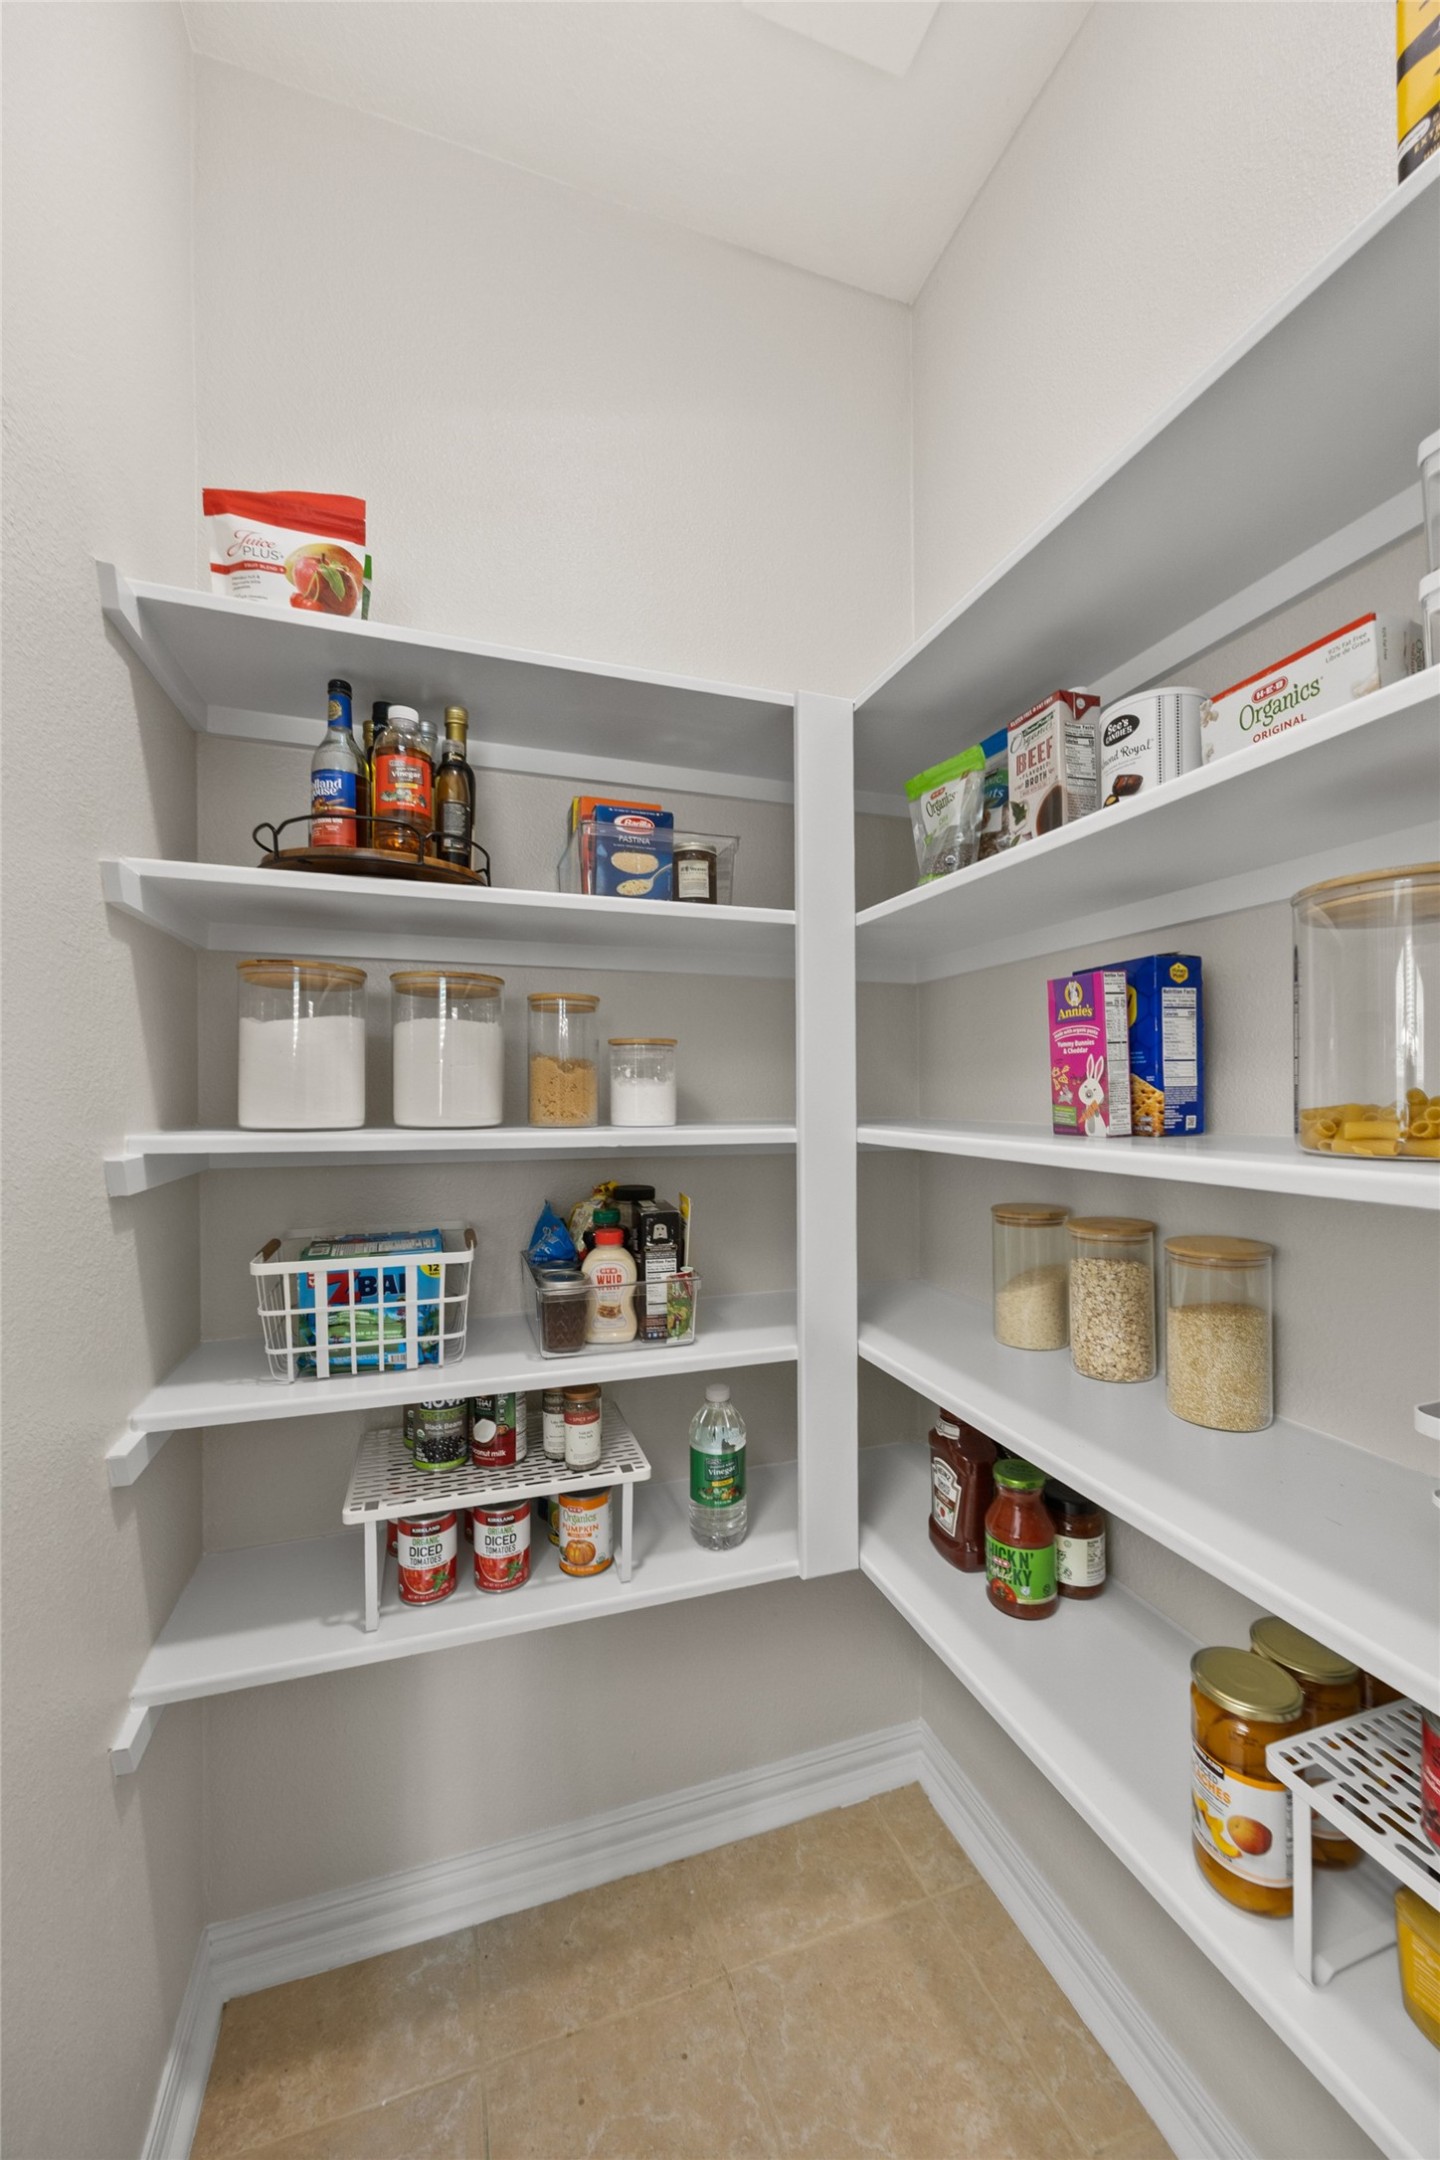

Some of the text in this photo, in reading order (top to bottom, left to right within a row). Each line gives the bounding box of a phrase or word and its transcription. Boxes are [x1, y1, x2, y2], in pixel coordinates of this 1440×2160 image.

[227, 530, 276, 557] Juice
[243, 546, 279, 561] PLUS
[1240, 678, 1321, 731] Organics
[1108, 719, 1129, 735] See's
[1252, 713, 1308, 743] ORIGINAL
[1105, 725, 1133, 745] CANDIES
[1016, 735, 1053, 776] BEEF
[1120, 738, 1151, 758] Royal
[1024, 771, 1048, 789] BROTH
[926, 791, 956, 818] Organics
[624, 818, 652, 828] Barilla
[618, 835, 651, 845] PASTINA
[1058, 1004, 1093, 1020] Annie's
[428, 1264, 439, 1272] 12
[491, 1449, 506, 1457] milk
[563, 1510, 597, 1525] Organics
[411, 1525, 440, 1533] KIRKLAND
[487, 1525, 515, 1535] ORGANIC
[562, 1523, 599, 1533] PUMPKIN
[412, 1535, 440, 1546] ORGANIC
[484, 1533, 517, 1546] DICED
[409, 1543, 443, 1558] DICED
[485, 1544, 516, 1554] TOMATOES
[409, 1554, 442, 1566] TOMATOES
